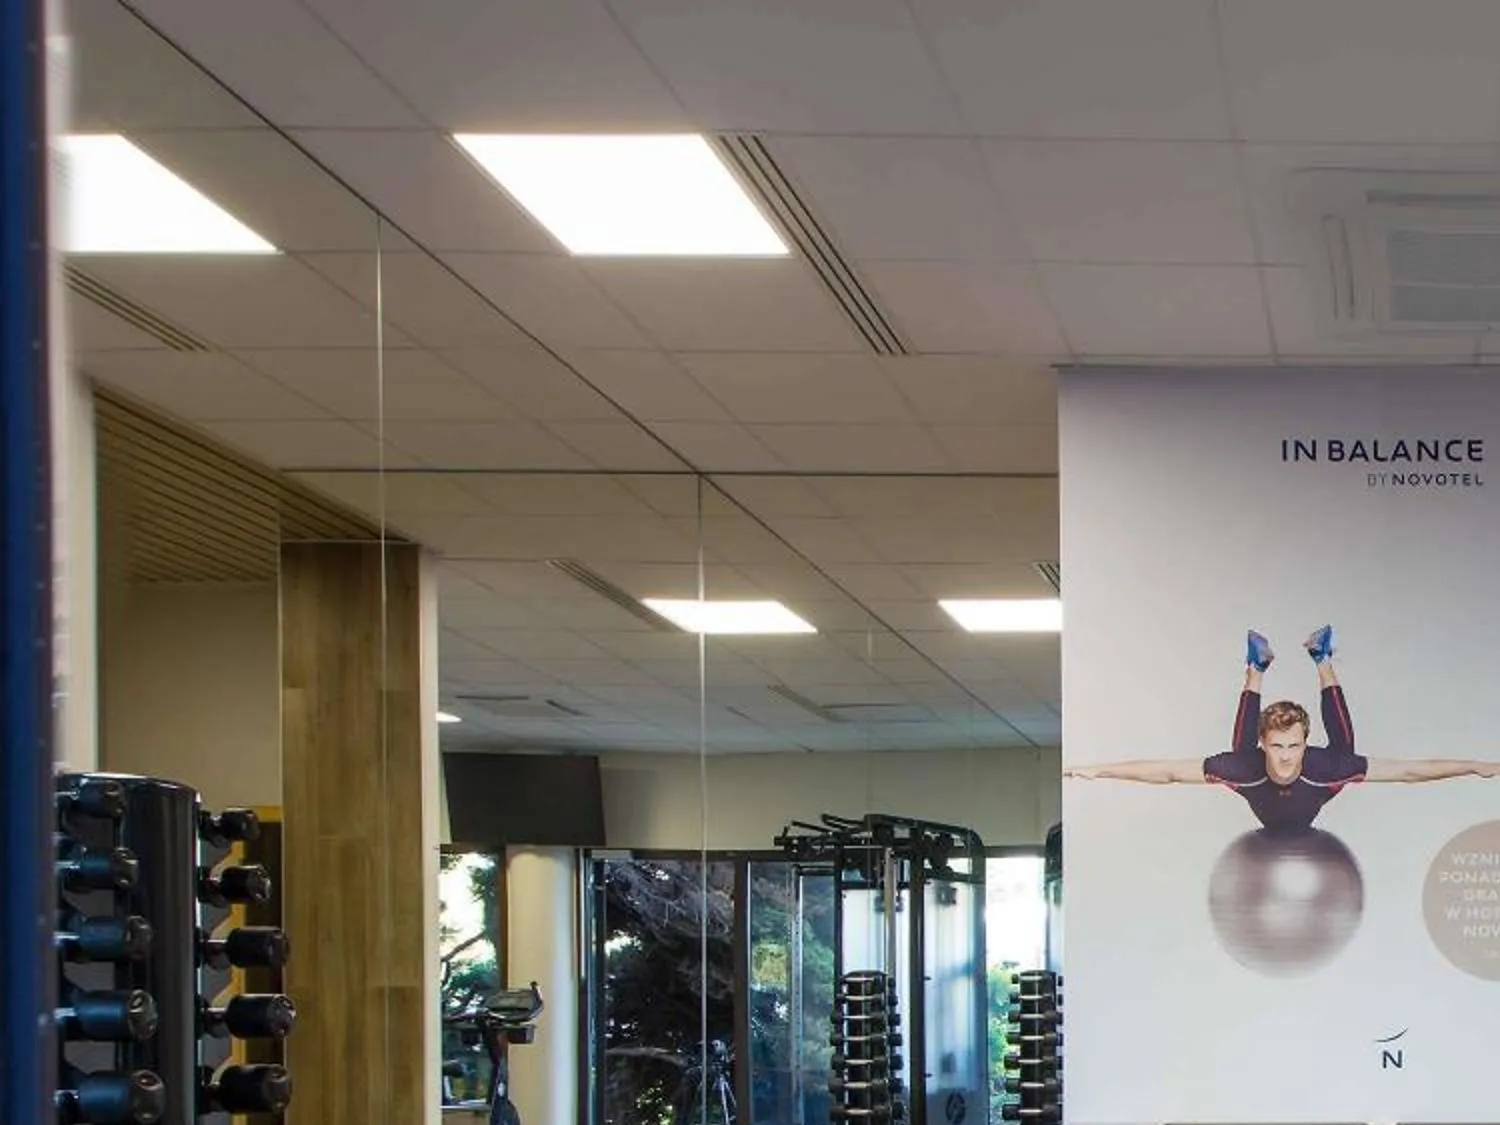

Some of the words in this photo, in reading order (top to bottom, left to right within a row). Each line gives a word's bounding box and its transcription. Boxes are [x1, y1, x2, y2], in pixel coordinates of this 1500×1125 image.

[1281, 439, 1318, 462] IN
[1326, 439, 1485, 462] BALANCE
[1367, 473, 1388, 487] BY
[1391, 473, 1485, 487] NOVOTEL
[1382, 1050, 1403, 1069] N
